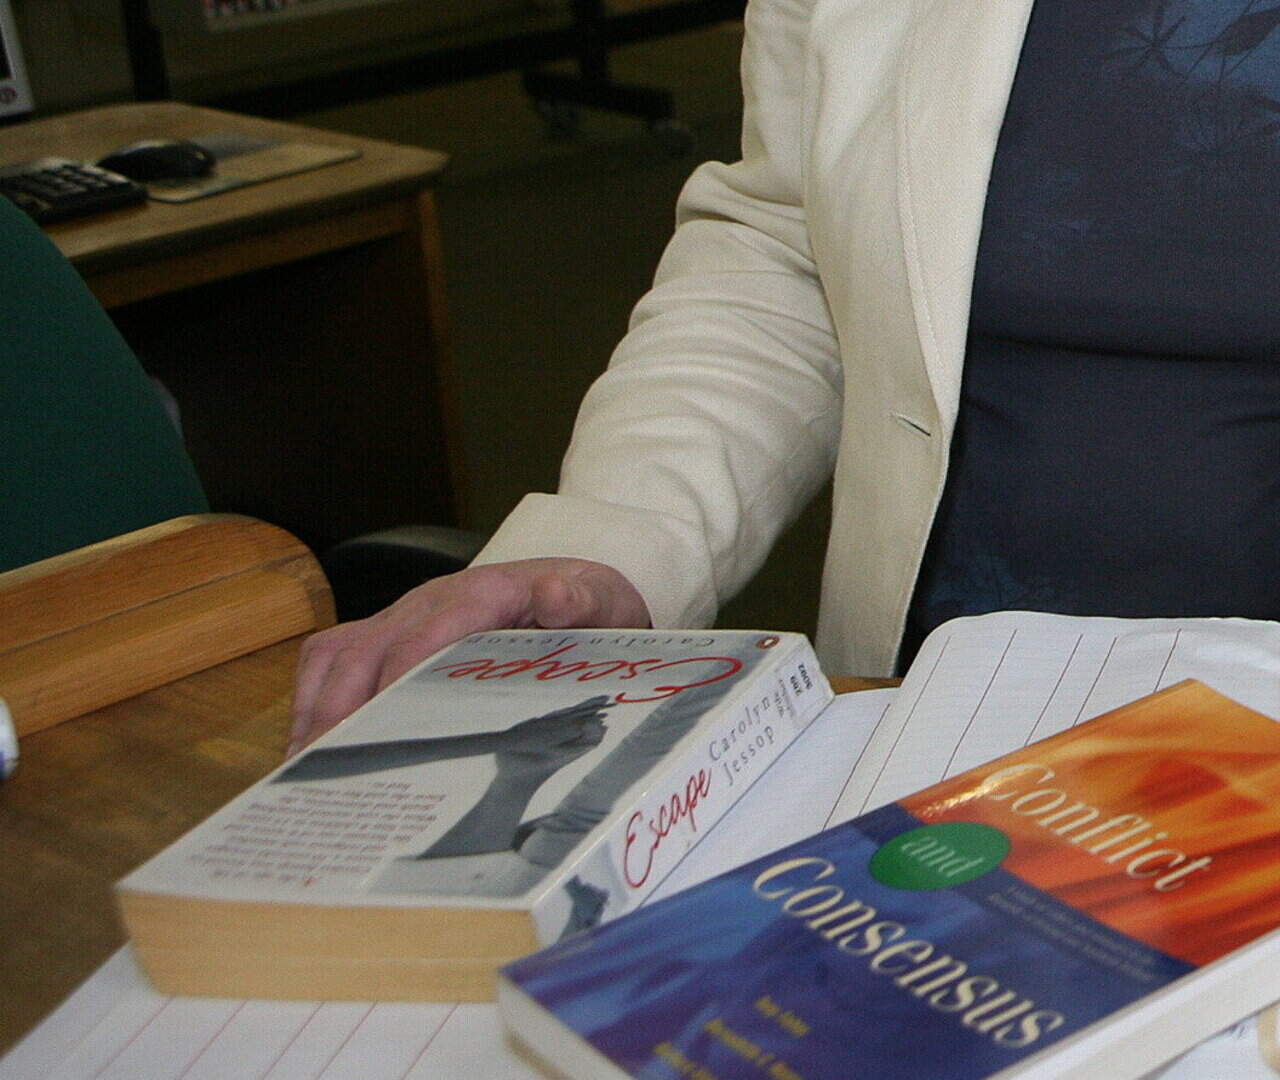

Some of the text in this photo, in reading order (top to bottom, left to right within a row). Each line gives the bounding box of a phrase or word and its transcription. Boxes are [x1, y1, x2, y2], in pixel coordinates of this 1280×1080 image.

[431, 642, 744, 704] Escape
[589, 636, 716, 648] Carolyn
[709, 696, 770, 762] Carolyn
[722, 725, 776, 787] Jessop
[624, 767, 713, 889] Escape
[901, 835, 986, 879] and
[983, 762, 1214, 893] Conflict
[752, 856, 1065, 1049] Consensus
